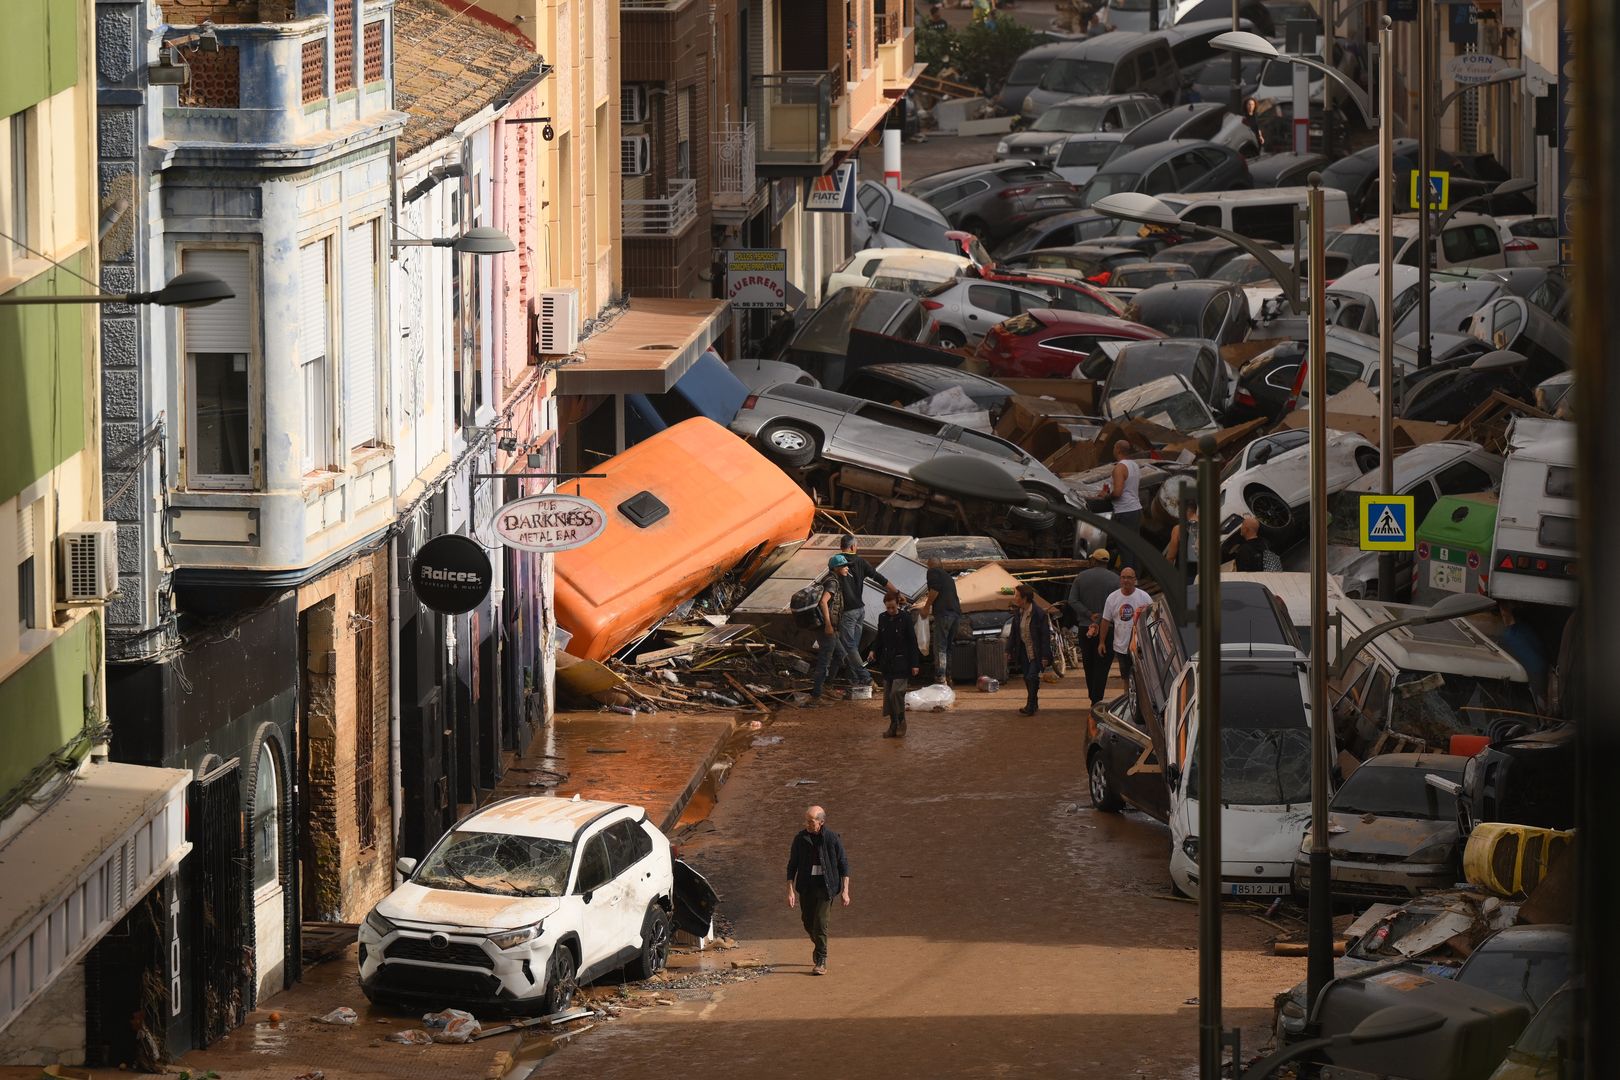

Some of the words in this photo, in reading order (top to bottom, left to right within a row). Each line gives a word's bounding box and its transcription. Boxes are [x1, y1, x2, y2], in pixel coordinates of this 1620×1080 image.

[1463, 56, 1493, 64] FORN
[812, 192, 840, 200] FIATC
[729, 276, 784, 298] GUERRERO
[504, 510, 594, 531] DARKNESS
[519, 530, 553, 543] METAL
[556, 529, 578, 541] BAR
[421, 565, 477, 582] Raices
[1238, 885, 1263, 894] 8512
